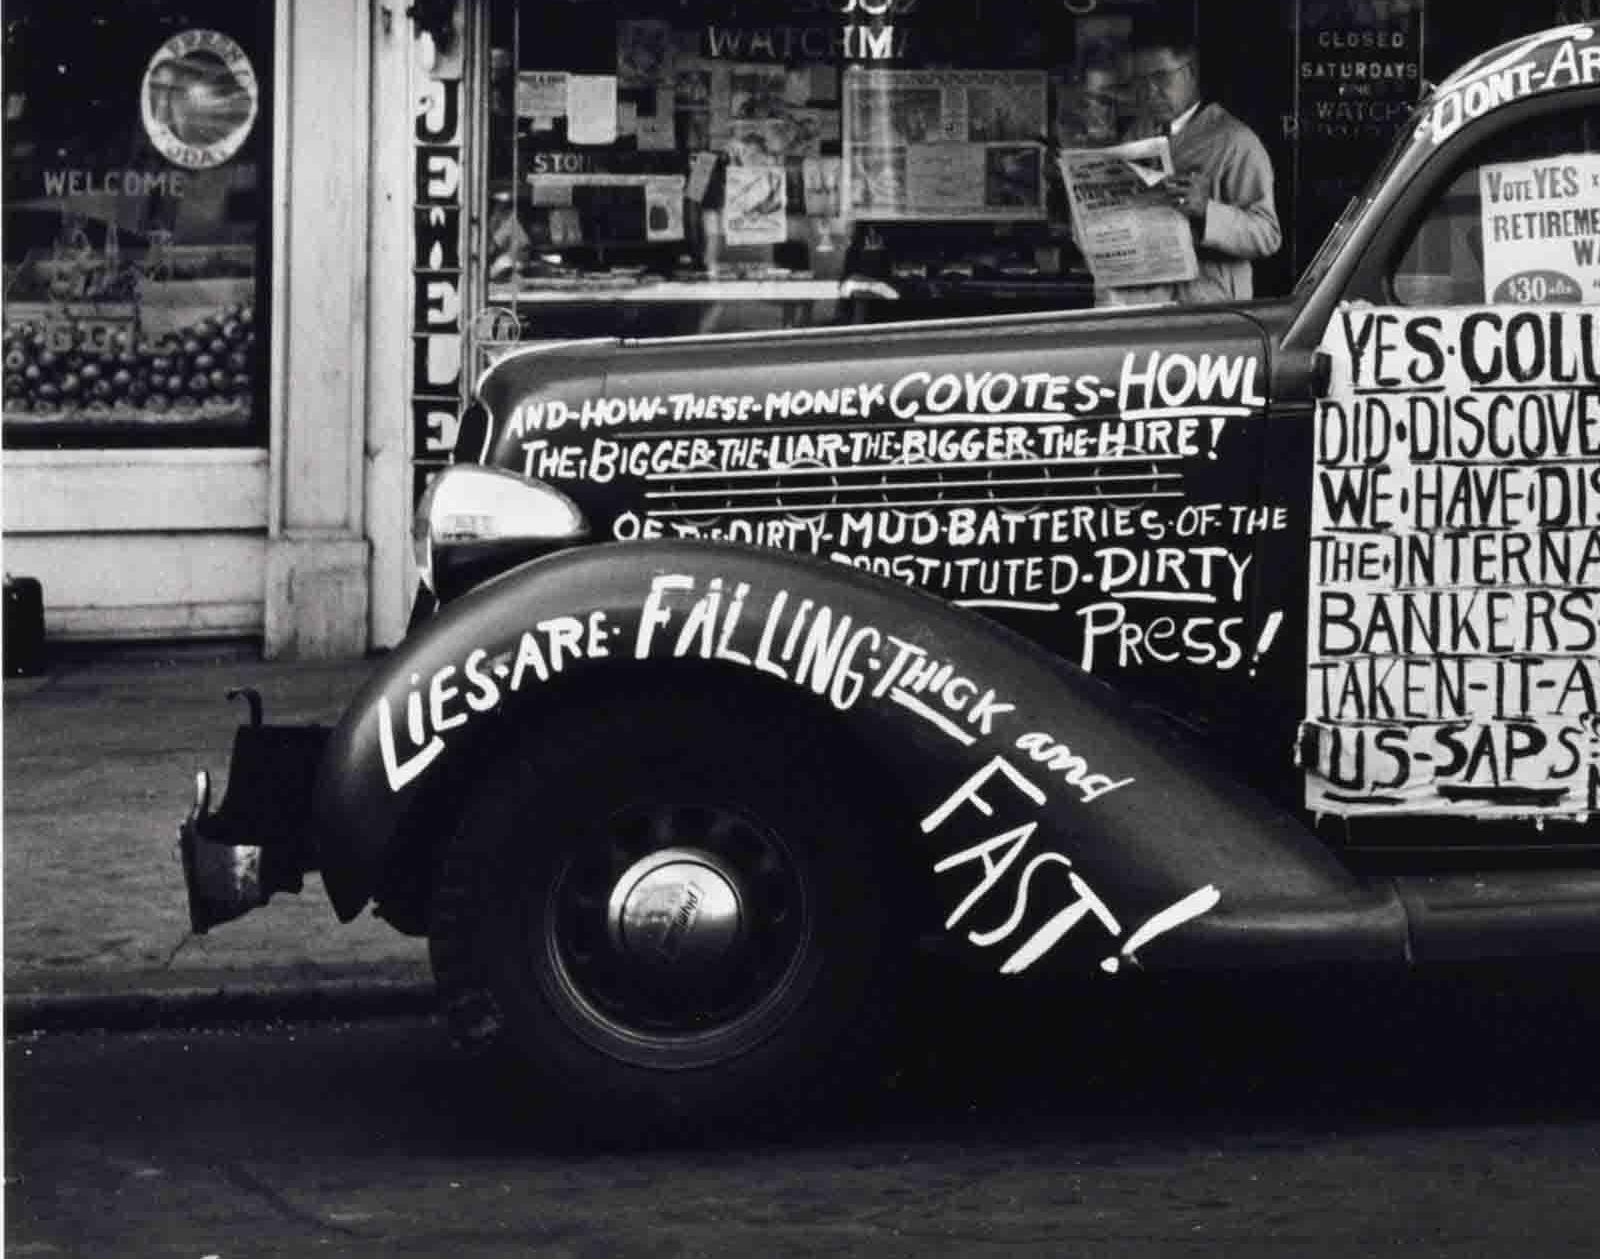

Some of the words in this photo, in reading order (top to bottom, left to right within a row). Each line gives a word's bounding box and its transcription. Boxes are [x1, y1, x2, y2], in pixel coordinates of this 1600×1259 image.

[1318, 31, 1405, 48] CLOSED
[1300, 61, 1418, 80] SATURDAYS
[43, 171, 185, 198] WELCOME
[1342, 309, 1447, 387] YES
[579, 394, 660, 431] HOW
[669, 393, 755, 422] THESE
[764, 382, 878, 422] MONEY
[888, 370, 1100, 419] COYOTES
[1119, 350, 1266, 408] HOWL
[902, 428, 1028, 463] BIGGER
[1318, 396, 1392, 466] DID
[1320, 465, 1393, 527] WE
[1414, 467, 1526, 528] HAVE
[839, 508, 938, 549] MUD
[947, 504, 1166, 546] BATTERIES
[1227, 504, 1289, 536] THE
[1093, 547, 1254, 602] DIRTY
[1312, 533, 1383, 582] THE
[1318, 590, 1598, 657] BANKERS
[1309, 658, 1467, 721] TAKEN
[1493, 657, 1544, 717] IT
[1014, 732, 1137, 804] and
